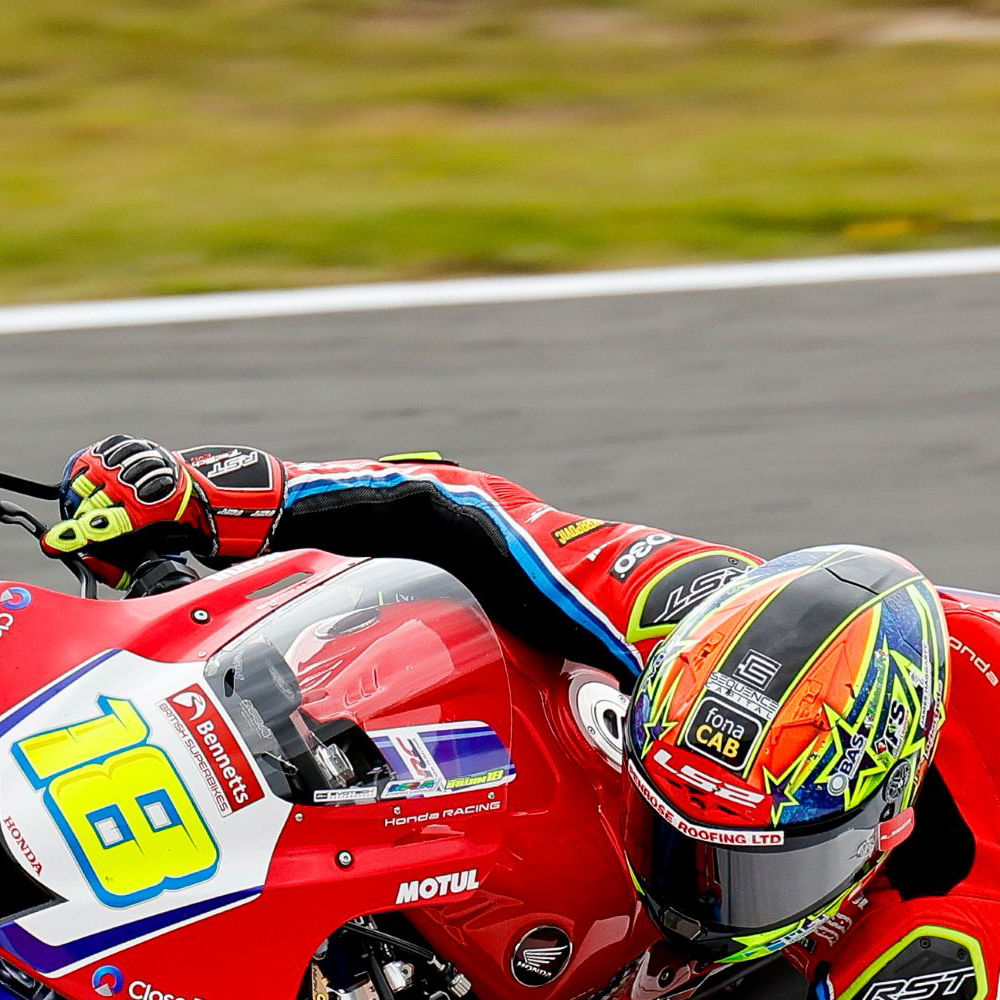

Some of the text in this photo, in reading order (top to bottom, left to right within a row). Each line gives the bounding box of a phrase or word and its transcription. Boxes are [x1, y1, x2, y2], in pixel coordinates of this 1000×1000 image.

[207, 451, 259, 479] RST
[949, 636, 999, 686] onda
[705, 683, 771, 720] CAPITAL
[709, 671, 780, 715] SEQUENCE
[696, 724, 741, 758] CAB
[705, 707, 745, 740] fona
[159, 702, 230, 812] BRITISH SUPERBIKES
[196, 720, 249, 804] Bennetts
[653, 749, 765, 809] LS2
[10, 694, 220, 908] 18
[384, 801, 501, 827] Honda RACING
[3, 815, 44, 877] HONDA
[677, 820, 746, 844] ROOFING
[752, 834, 782, 844] LTD
[395, 868, 480, 905] MOTUL
[516, 960, 552, 977] HONDA
